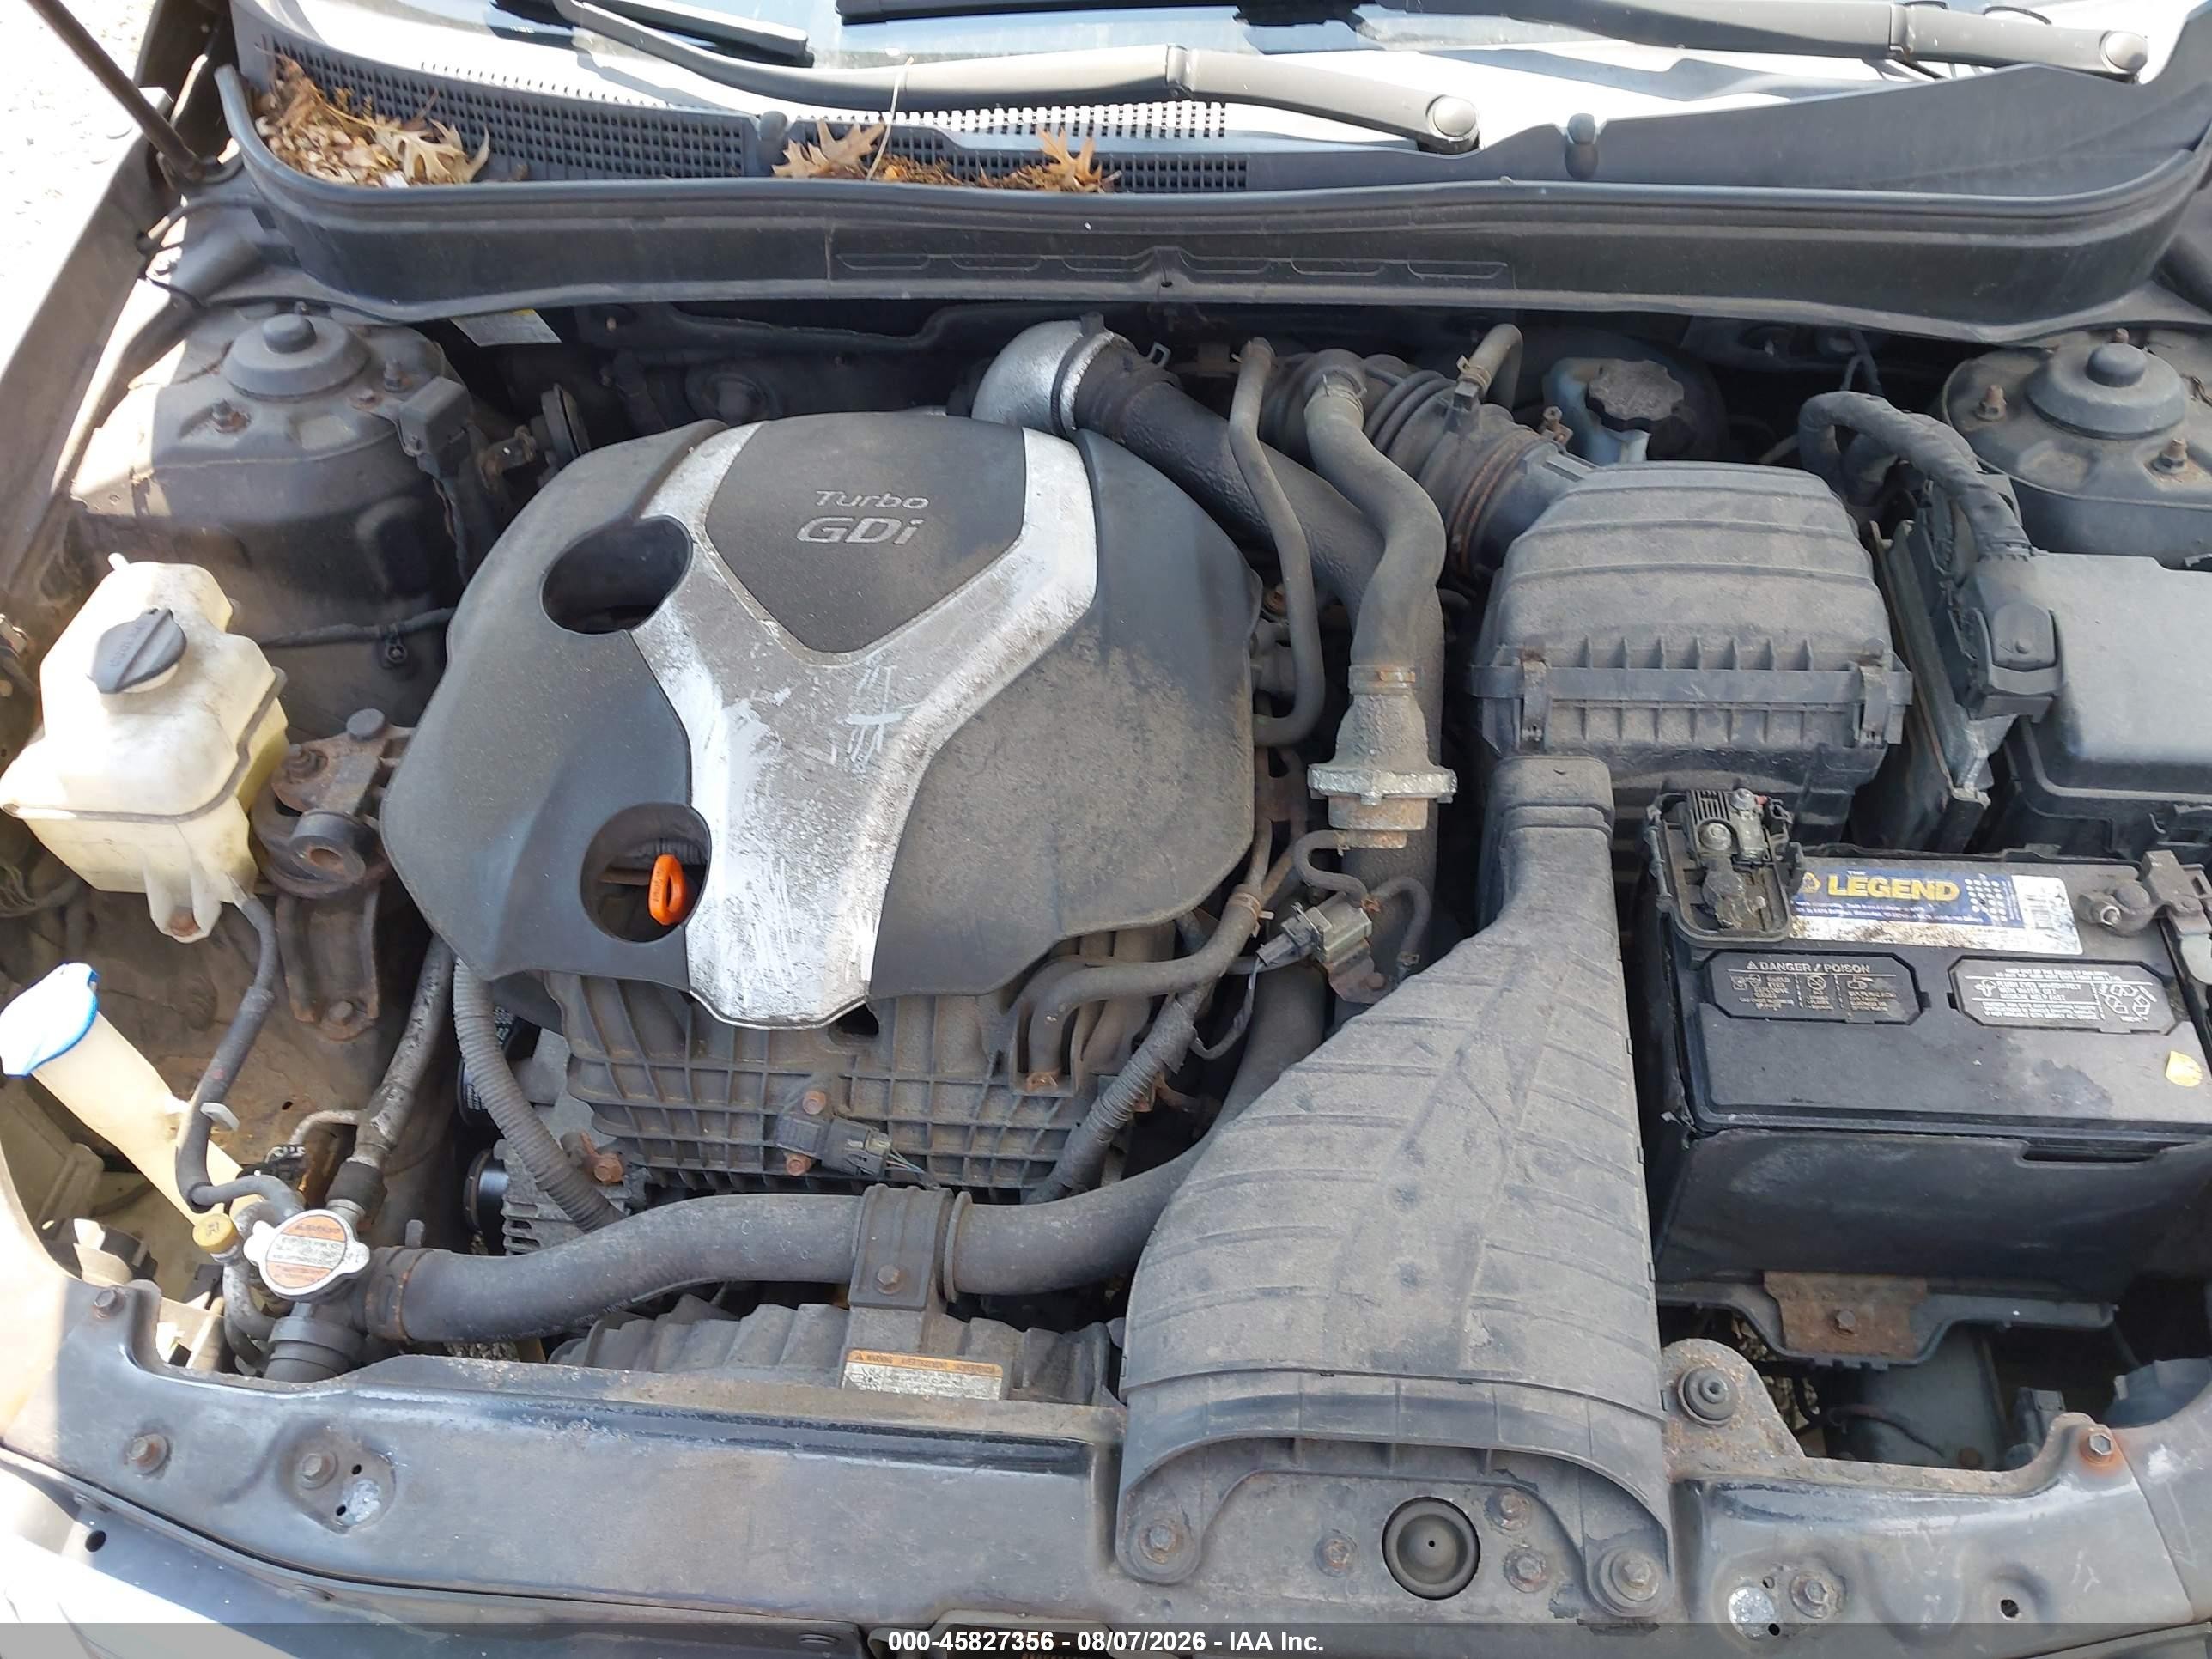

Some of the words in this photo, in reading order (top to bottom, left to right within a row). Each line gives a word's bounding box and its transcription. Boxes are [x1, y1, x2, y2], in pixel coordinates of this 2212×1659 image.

[816, 490, 929, 509] Turbo
[796, 517, 925, 544] GDi
[1827, 874, 1960, 902] LEGEND
[1759, 961, 1811, 972] DANGER
[1823, 963, 1870, 973] POISON
